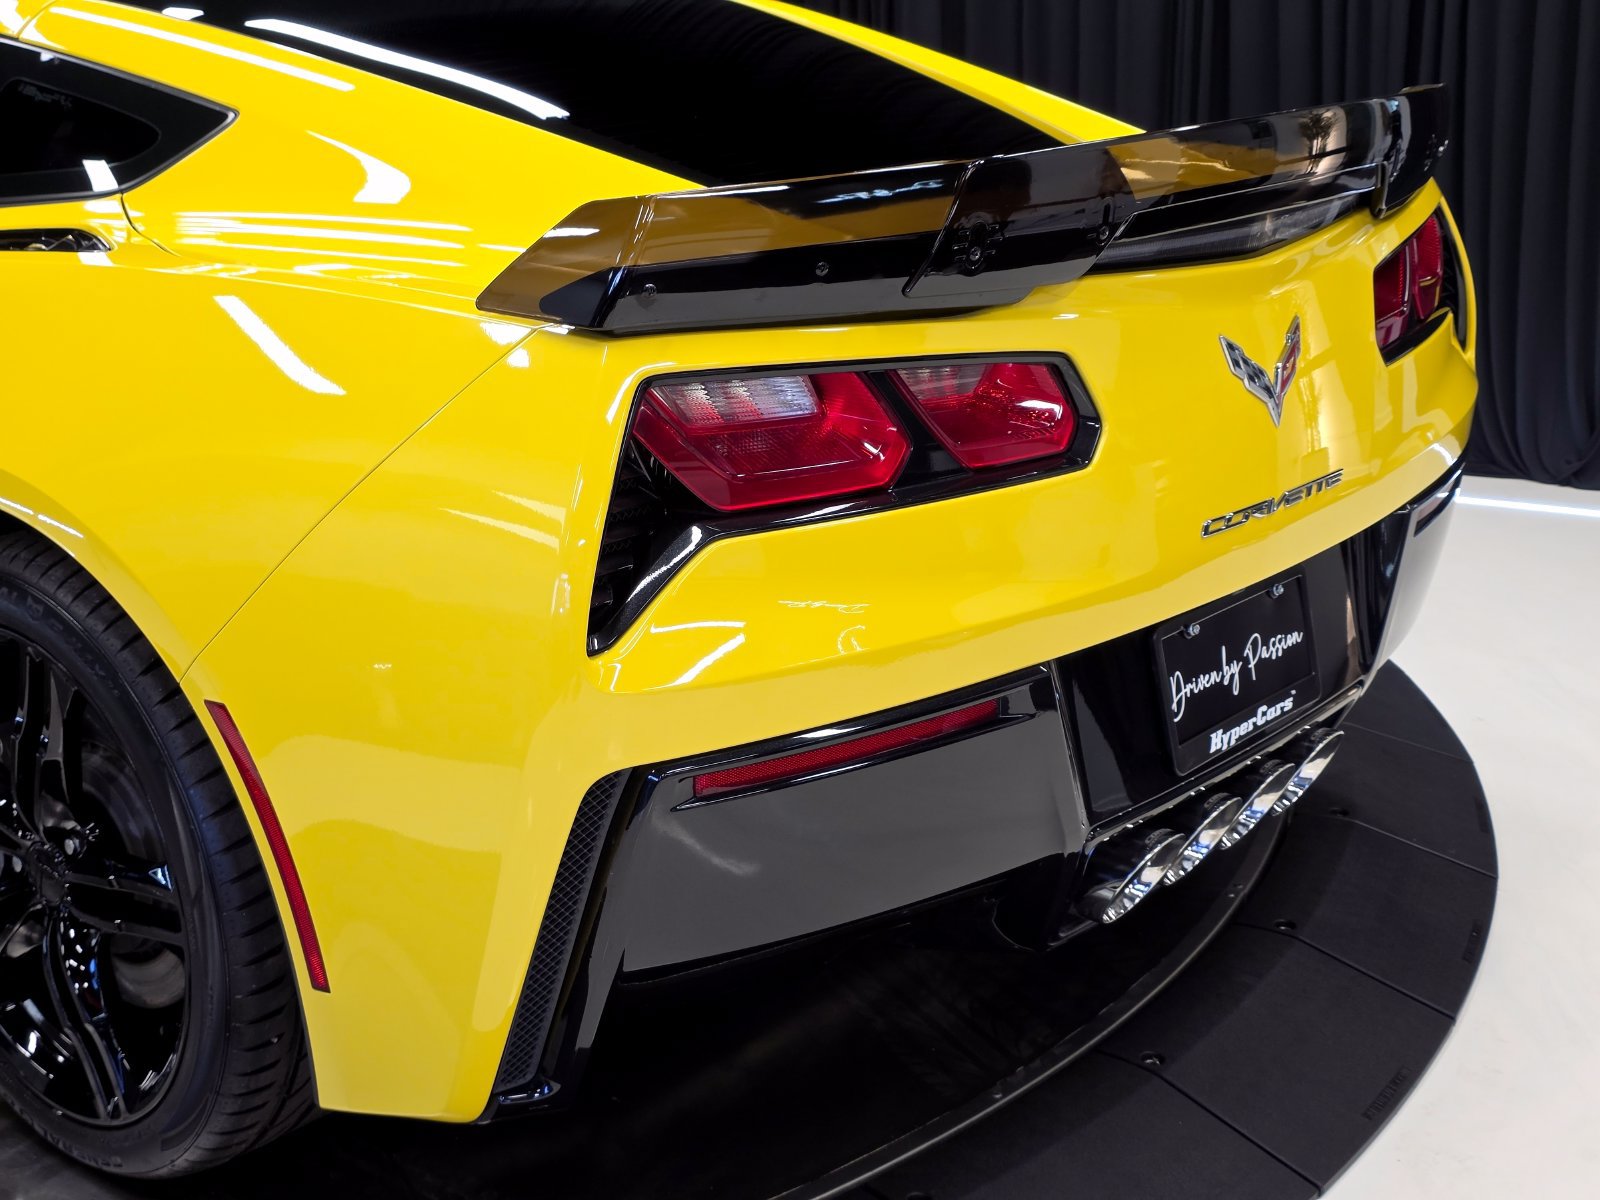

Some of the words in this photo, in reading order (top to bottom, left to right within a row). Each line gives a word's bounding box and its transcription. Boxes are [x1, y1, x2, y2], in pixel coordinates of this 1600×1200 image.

[1201, 468, 1344, 538] CORVETTE
[1168, 670, 1223, 723] Driven
[1221, 645, 1243, 696] by
[1242, 631, 1304, 681] Passion
